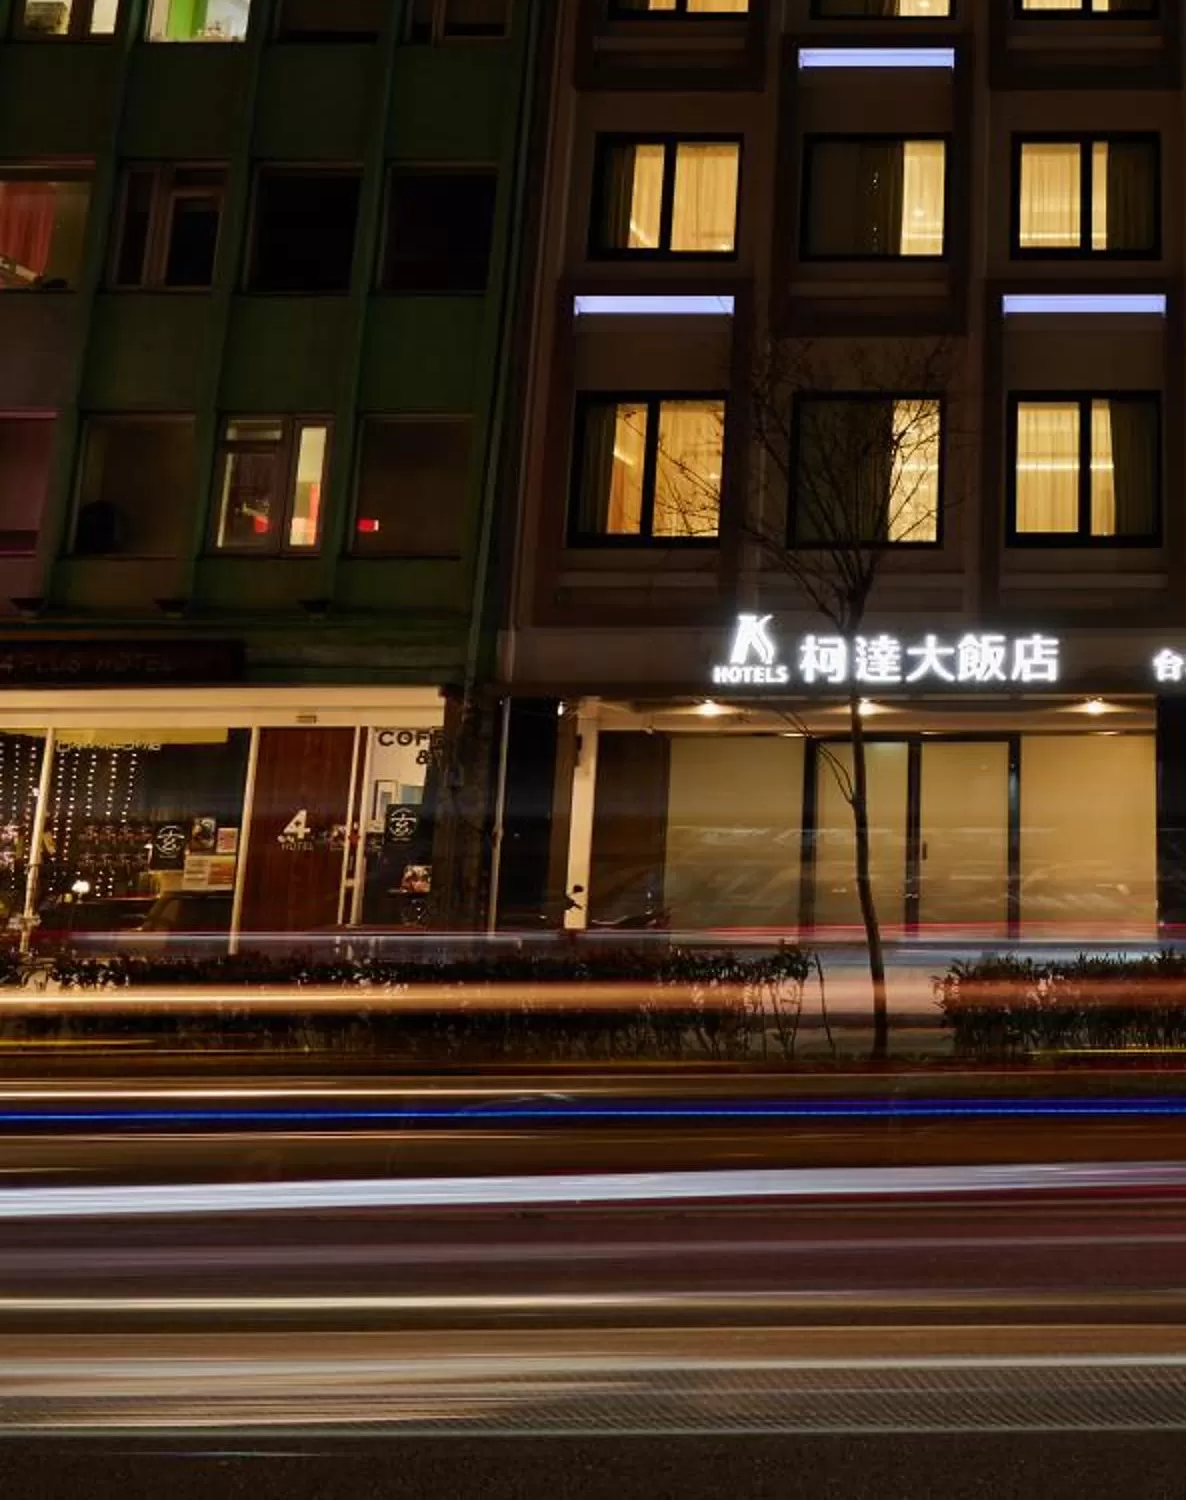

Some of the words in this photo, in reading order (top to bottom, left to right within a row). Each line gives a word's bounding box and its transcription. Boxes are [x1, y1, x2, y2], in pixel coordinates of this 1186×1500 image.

[800, 634, 1060, 683] 柯達大飯店
[713, 665, 790, 684] HOTELS
[283, 809, 312, 840] 4
